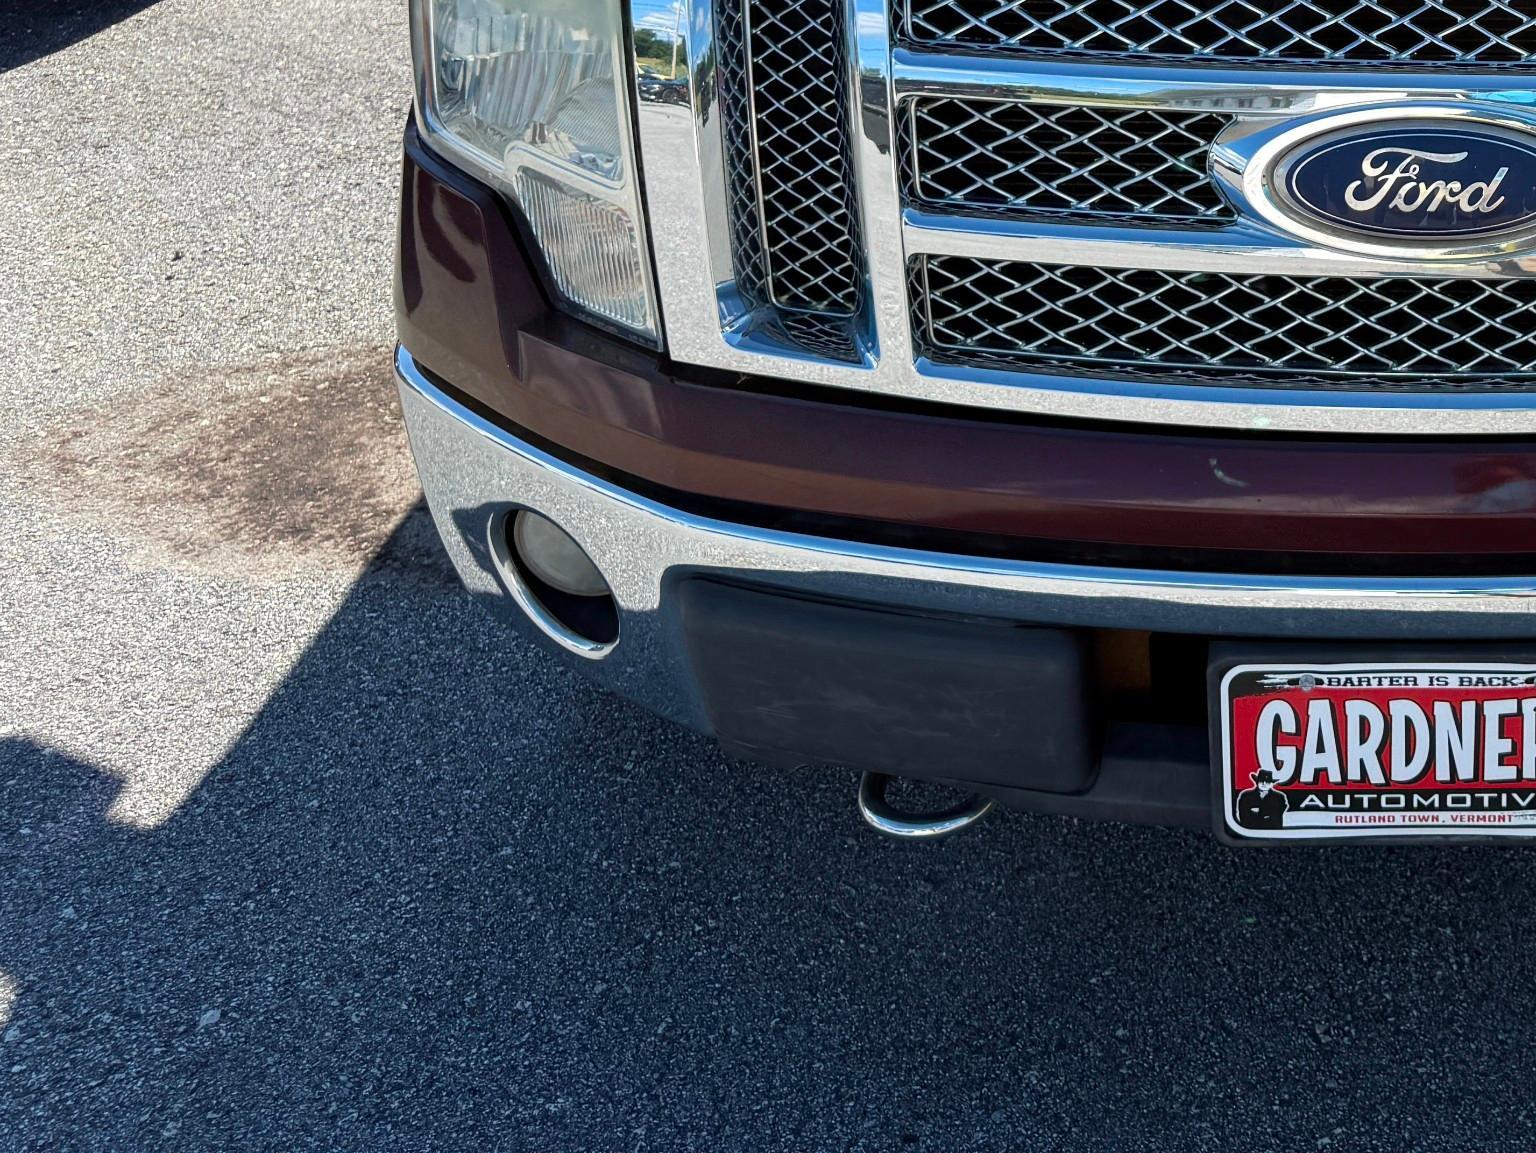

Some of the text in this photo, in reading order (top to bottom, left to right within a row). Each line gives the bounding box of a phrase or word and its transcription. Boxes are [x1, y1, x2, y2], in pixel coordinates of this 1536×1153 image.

[1344, 147, 1509, 213] Ford
[1326, 676, 1519, 687] BARTER IS BACK
[1335, 814, 1396, 824] RUTLAND
[1451, 813, 1514, 824] VERMONT
